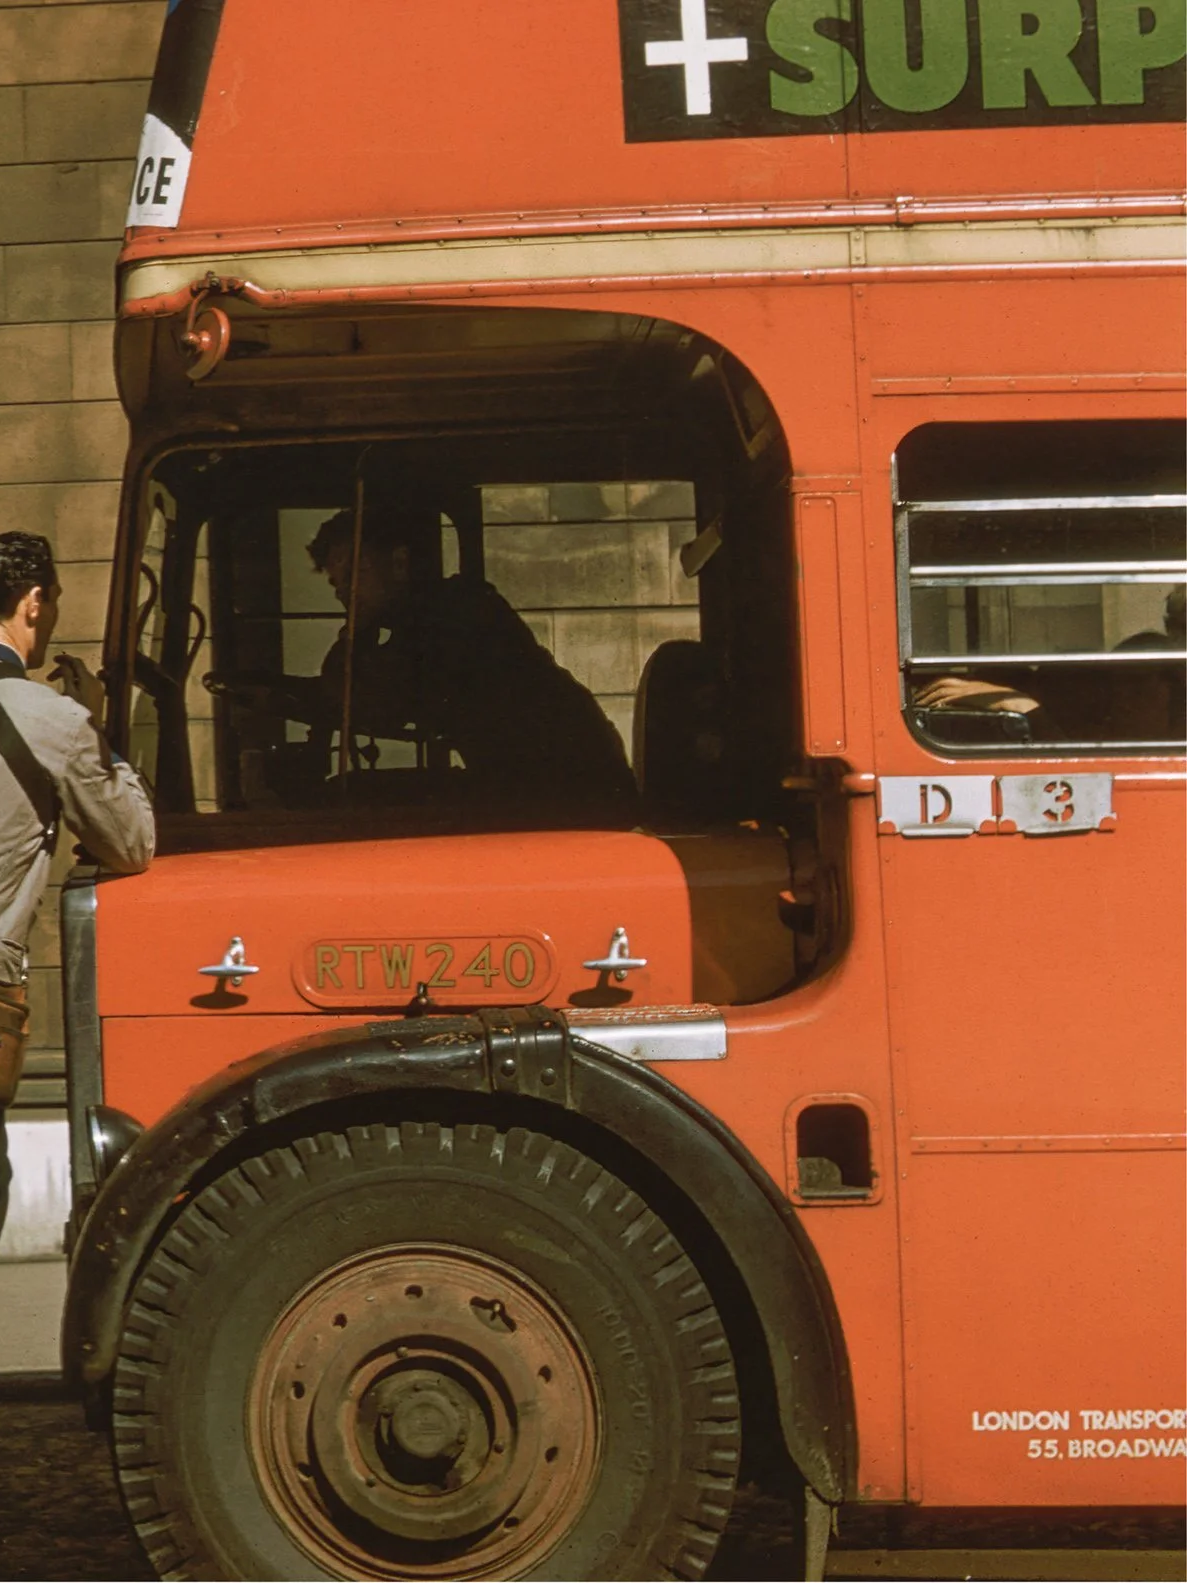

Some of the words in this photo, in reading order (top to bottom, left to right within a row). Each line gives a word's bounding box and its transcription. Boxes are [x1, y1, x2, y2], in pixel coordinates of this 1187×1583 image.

[764, 0, 1187, 115] SURP
[136, 156, 175, 205] CE
[919, 784, 952, 824] D
[1043, 781, 1074, 822] 3
[972, 1411, 1070, 1431] LONDON
